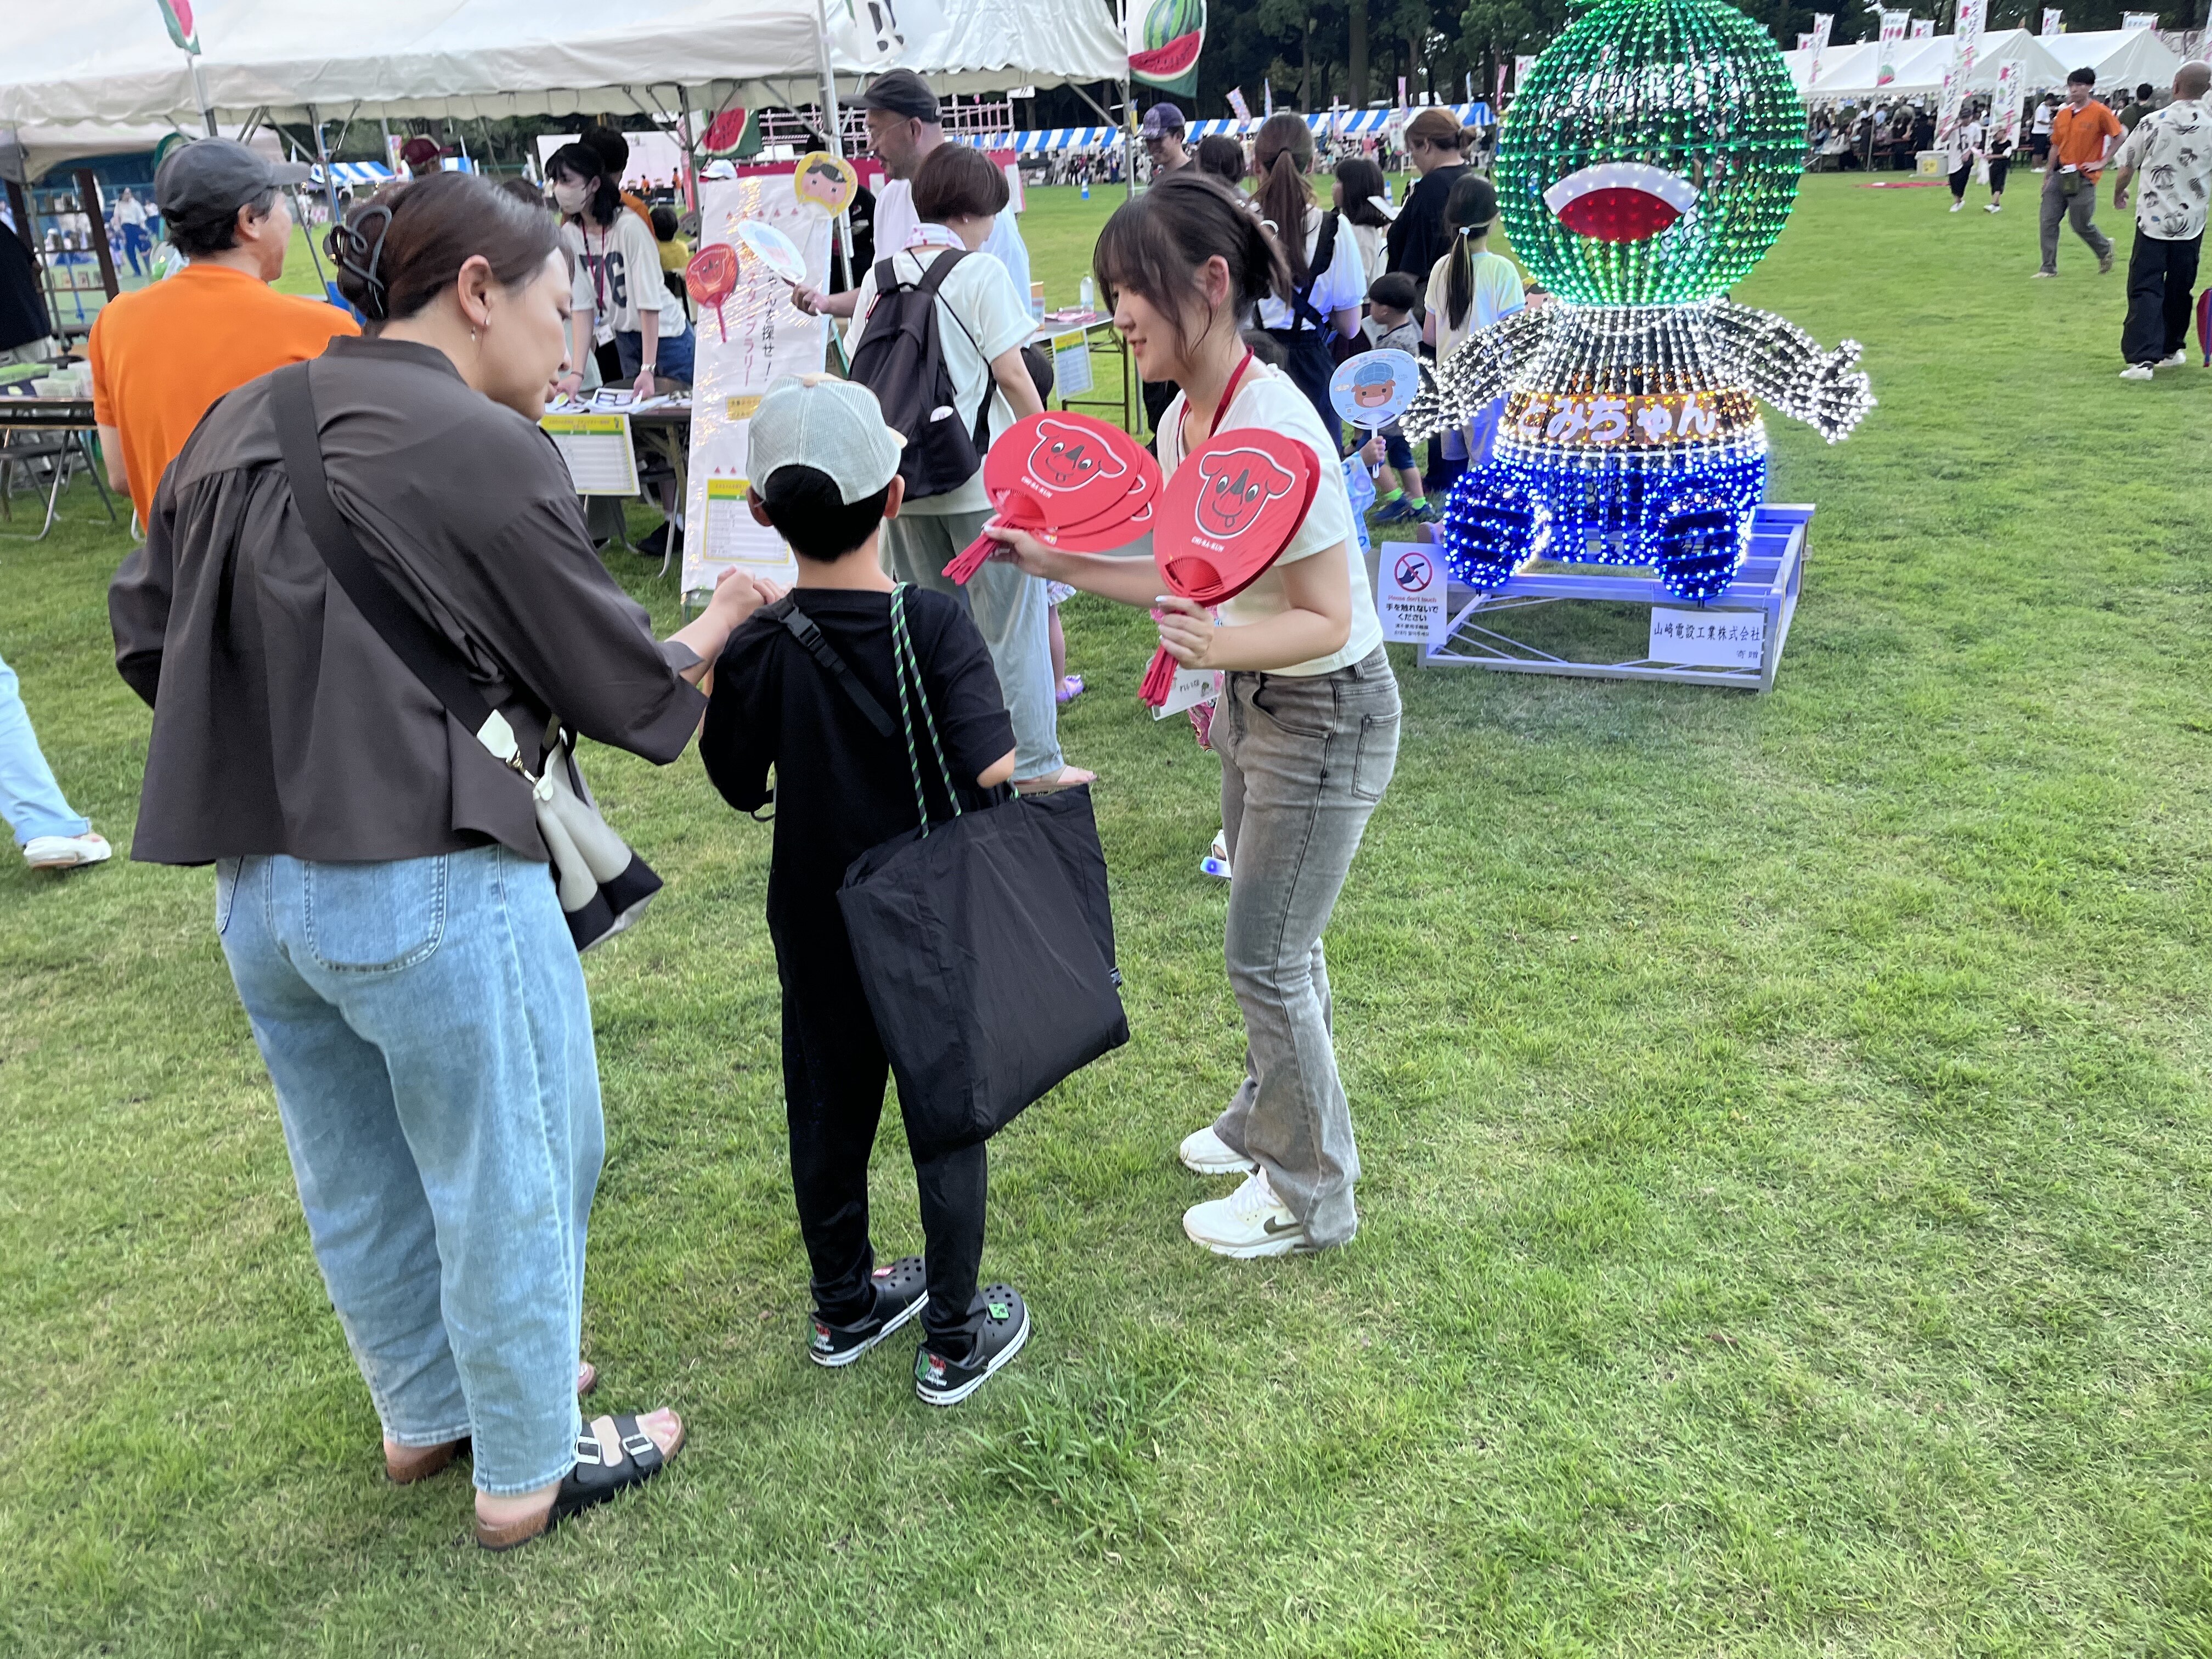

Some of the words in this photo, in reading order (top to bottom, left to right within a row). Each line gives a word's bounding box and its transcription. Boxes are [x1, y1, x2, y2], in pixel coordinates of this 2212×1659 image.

[1519, 393, 1716, 442] とみちゃん
[1386, 603, 1438, 613] 手を触れないで
[1398, 613, 1427, 622] ください
